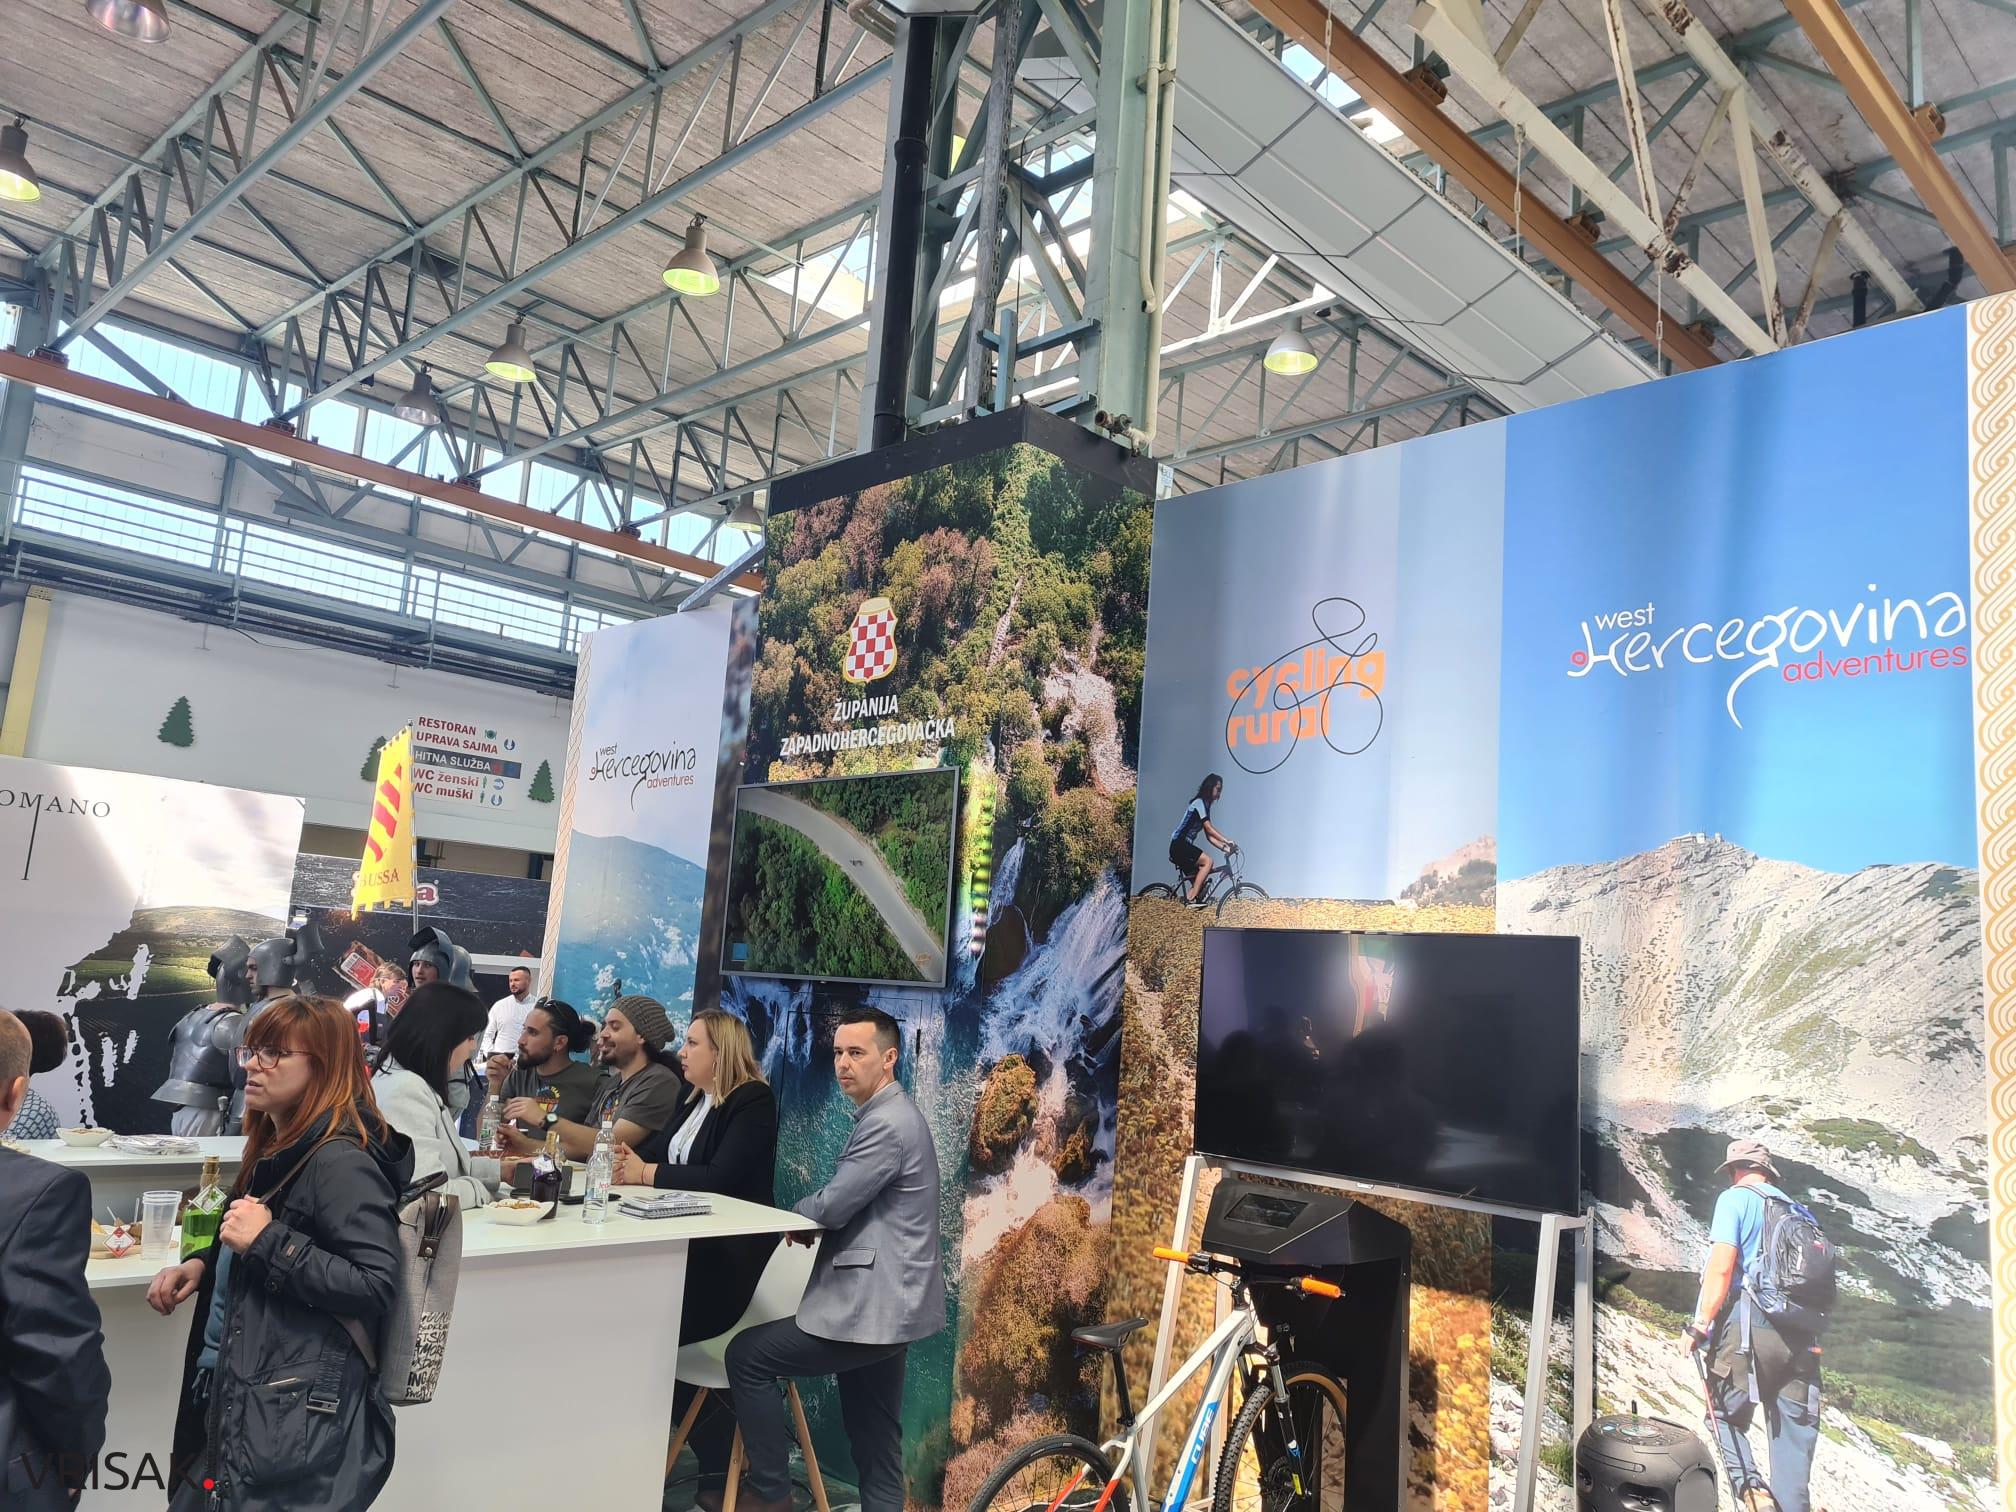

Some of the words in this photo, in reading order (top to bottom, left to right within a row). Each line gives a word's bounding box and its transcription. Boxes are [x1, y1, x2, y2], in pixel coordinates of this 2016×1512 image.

[1594, 601, 1656, 631] west
[1567, 583, 1967, 729] Hercegovina
[1782, 644, 1968, 683] adventures
[1226, 647, 1387, 709] cycling
[833, 694, 899, 722] ŽUPANIJA
[1227, 693, 1331, 748] rural
[418, 716, 477, 736] RESTORAN
[780, 715, 955, 757] ZAPADNOHERCEGOVAČKA
[416, 731, 460, 748] UPRAVA
[462, 740, 498, 755] SAJMA
[599, 742, 618, 756] west
[414, 750, 447, 767] HITNA
[450, 756, 491, 772] SLUŽBA
[413, 767, 435, 781] WC
[437, 771, 479, 788] ženski
[588, 740, 697, 812] Hercegovina
[646, 773, 694, 789] adventures
[436, 786, 473, 800] muški
